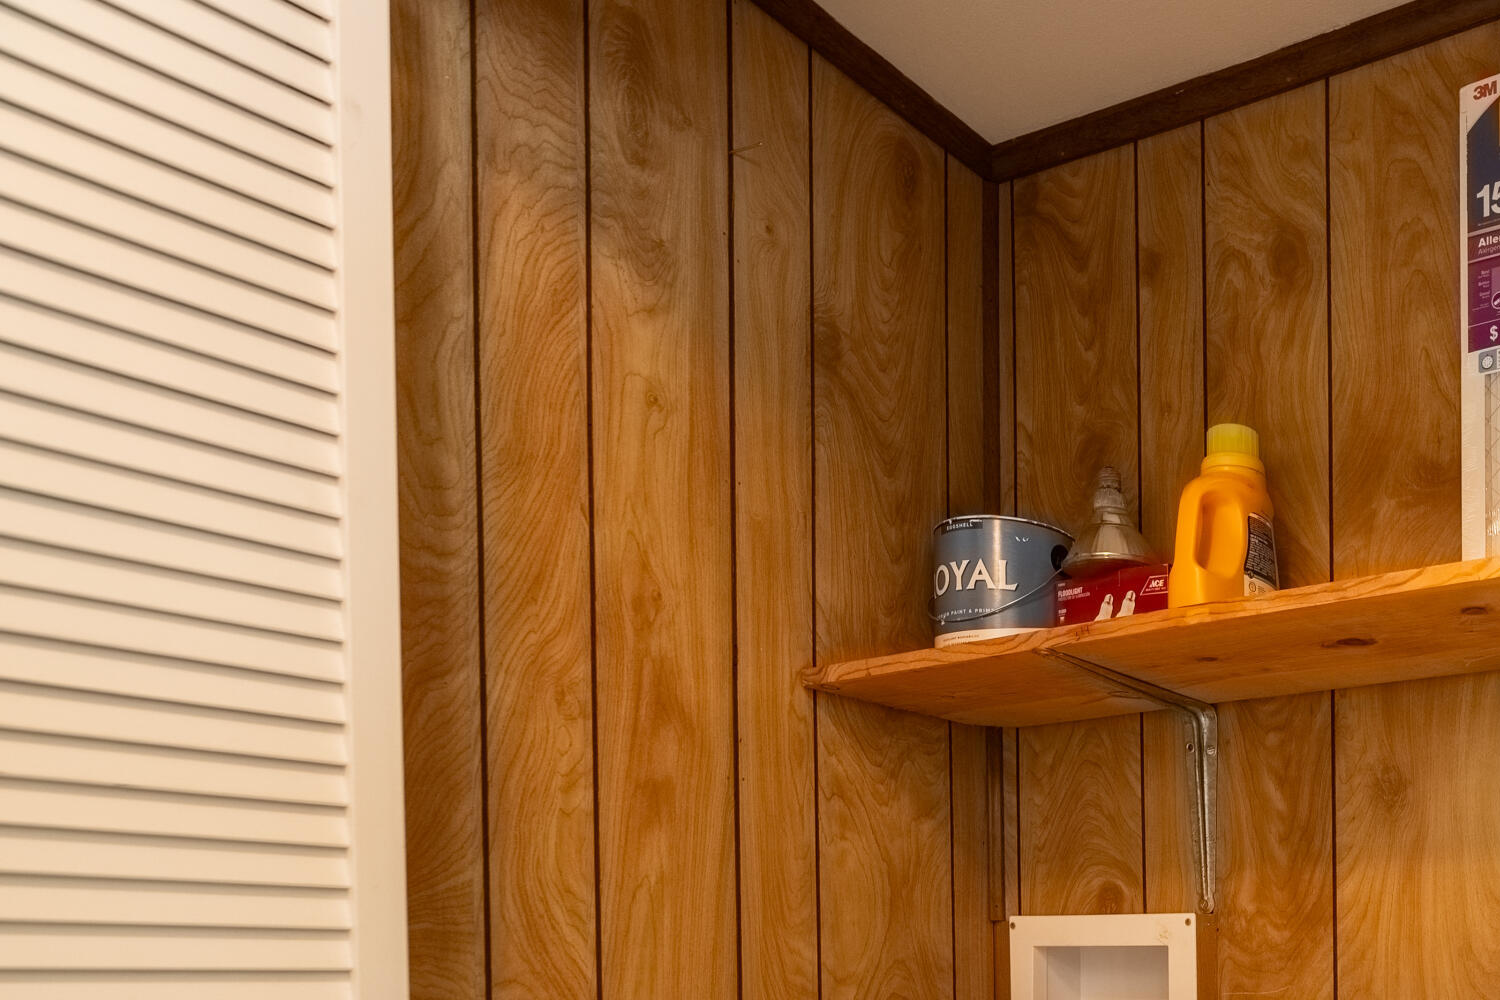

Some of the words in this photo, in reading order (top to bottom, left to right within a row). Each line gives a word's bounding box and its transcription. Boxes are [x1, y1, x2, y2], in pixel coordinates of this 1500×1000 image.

[1473, 80, 1498, 100] 3M
[934, 557, 1018, 599] OYAL
[1149, 579, 1165, 588] ACE
